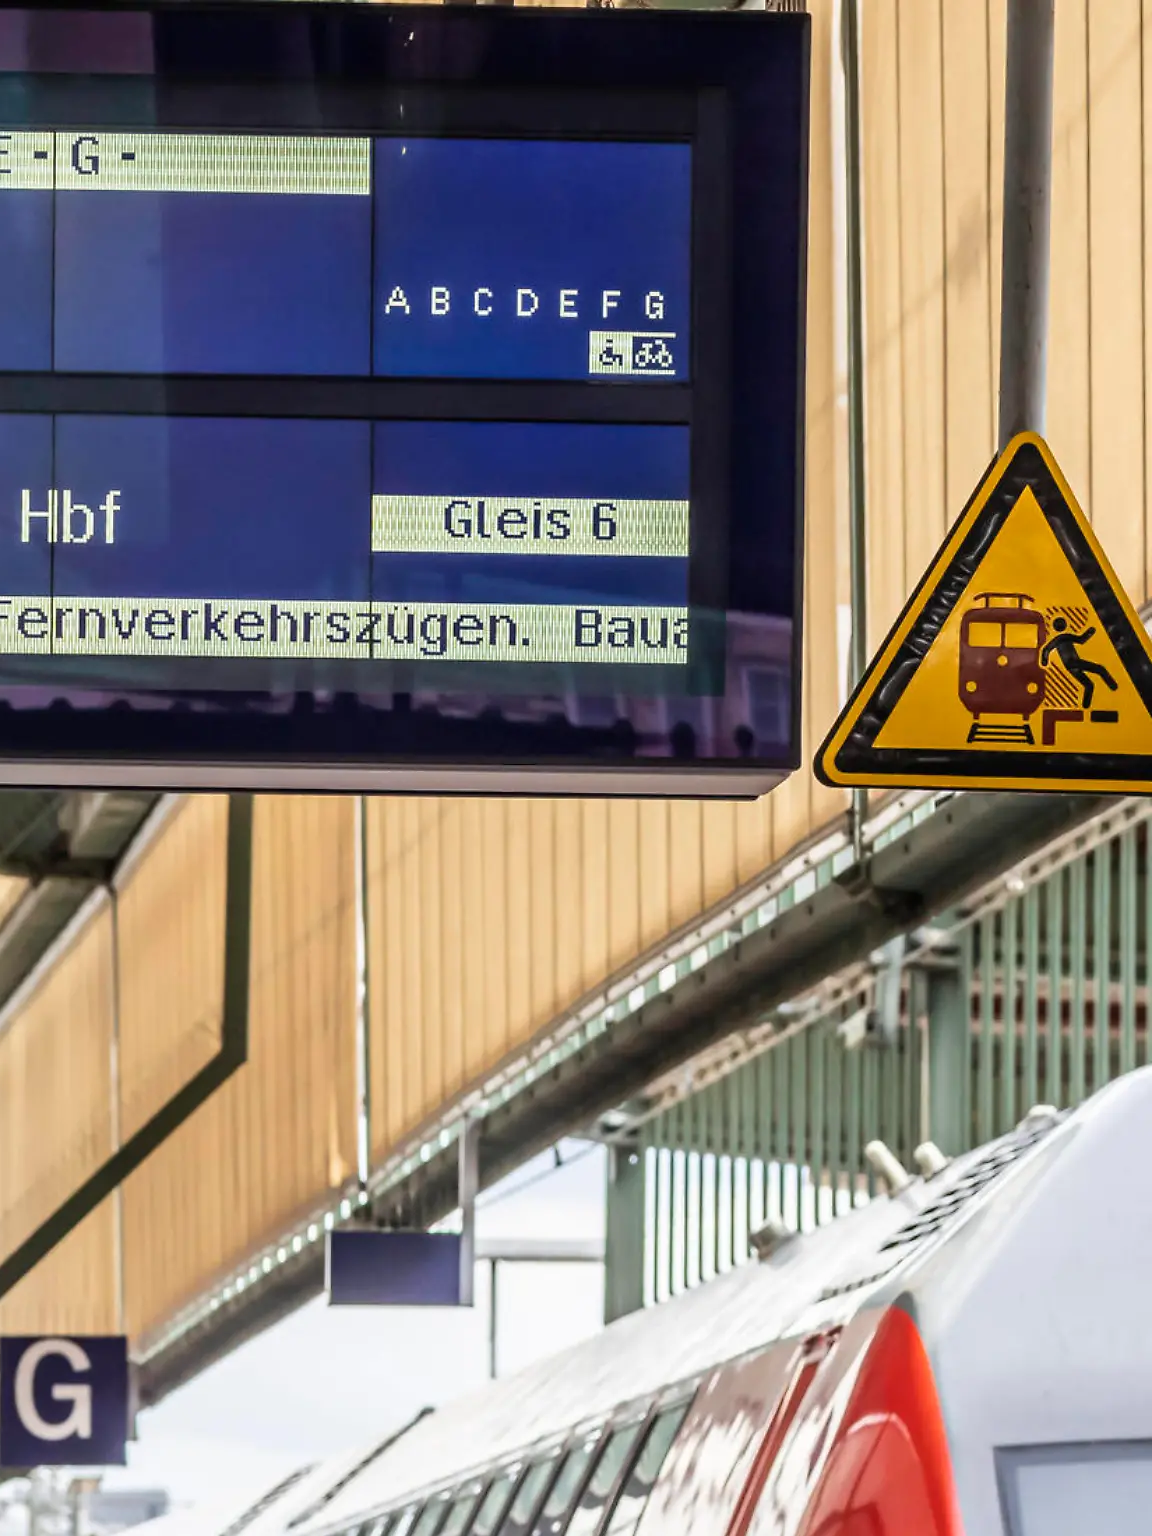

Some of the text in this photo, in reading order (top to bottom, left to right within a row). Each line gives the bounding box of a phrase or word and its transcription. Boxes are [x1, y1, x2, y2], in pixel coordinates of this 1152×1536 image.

[71, 136, 100, 176] G
[384, 285, 664, 320] A B C D E F G
[21, 489, 121, 544] Hbf
[444, 500, 571, 540] Gleis
[592, 502, 617, 541] 6
[14, 1338, 92, 1441] G
